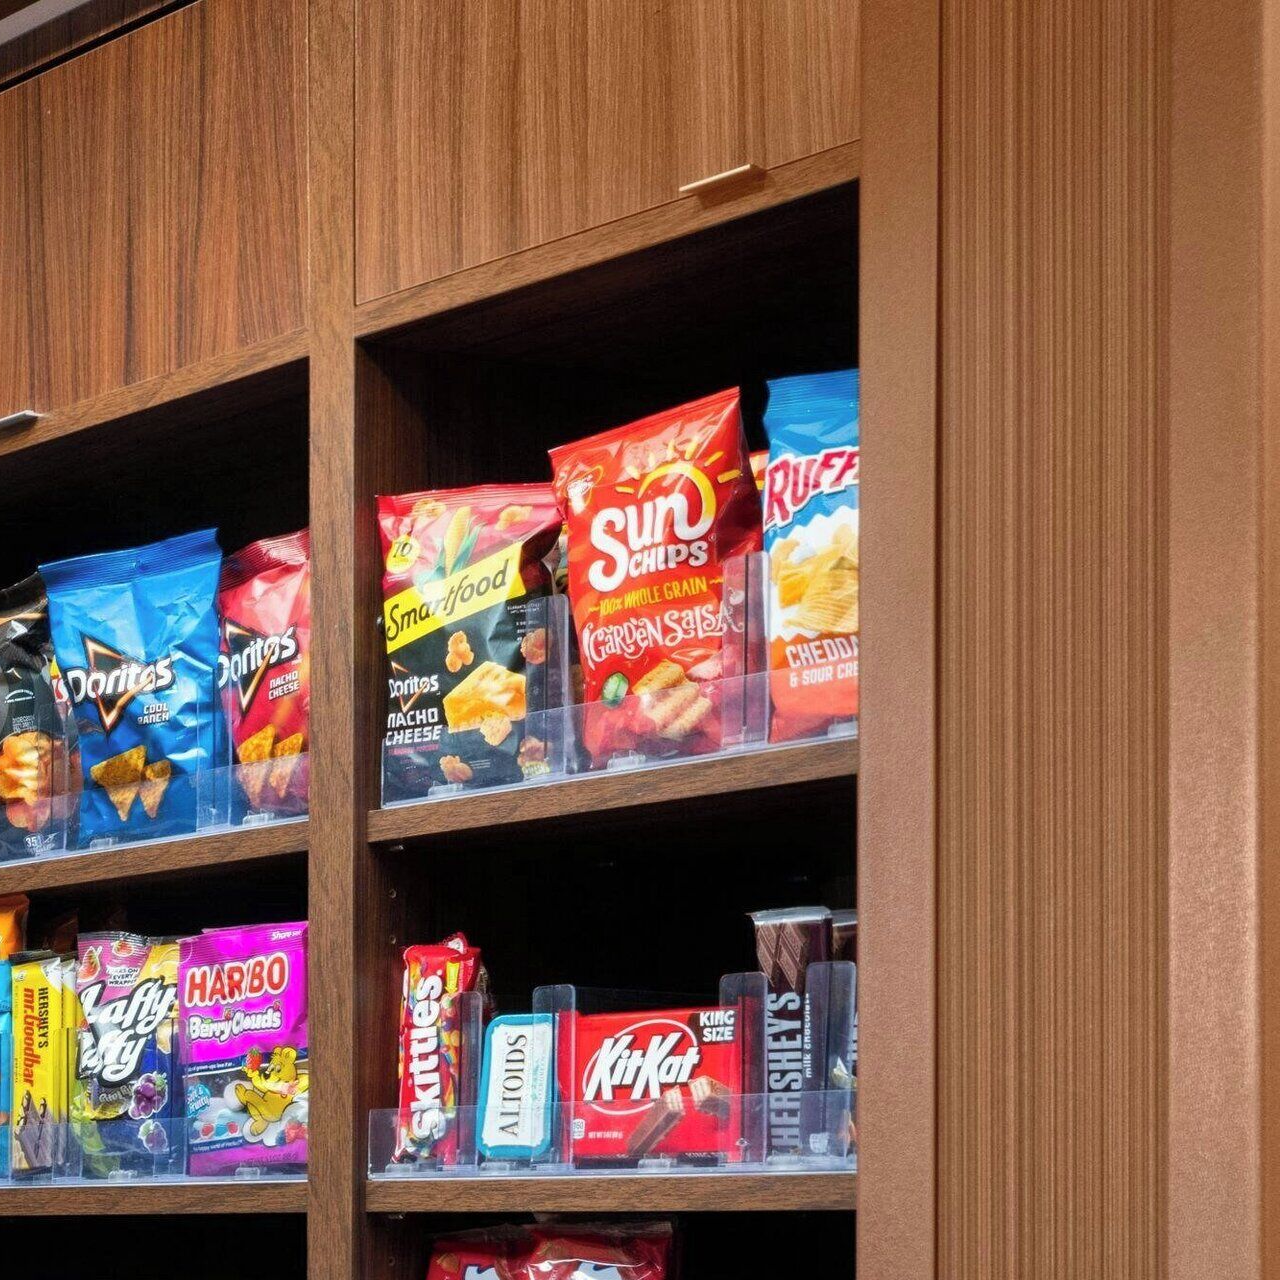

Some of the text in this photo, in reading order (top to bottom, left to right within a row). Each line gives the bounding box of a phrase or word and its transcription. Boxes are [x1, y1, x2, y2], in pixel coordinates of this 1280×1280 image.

[589, 490, 716, 592] Sun
[629, 541, 709, 578] CHIPS
[386, 559, 510, 641] Smartfood
[624, 576, 707, 610] WHOLE GRAIN
[218, 626, 297, 688] Doritos
[66, 657, 173, 704] Doritos
[269, 682, 300, 700] CHEESE
[388, 675, 439, 697] Doritos
[144, 703, 168, 715] COOL
[386, 725, 442, 746] CHEESE
[186, 953, 288, 1007] HARIBO
[80, 975, 178, 1034] Laffy
[700, 1011, 734, 1027] KING
[190, 1010, 282, 1043] Berry Clouds
[702, 1027, 734, 1042] SIZE
[499, 1033, 528, 1137] ALTOIDS
[768, 991, 803, 1152] HERSHEY'S
